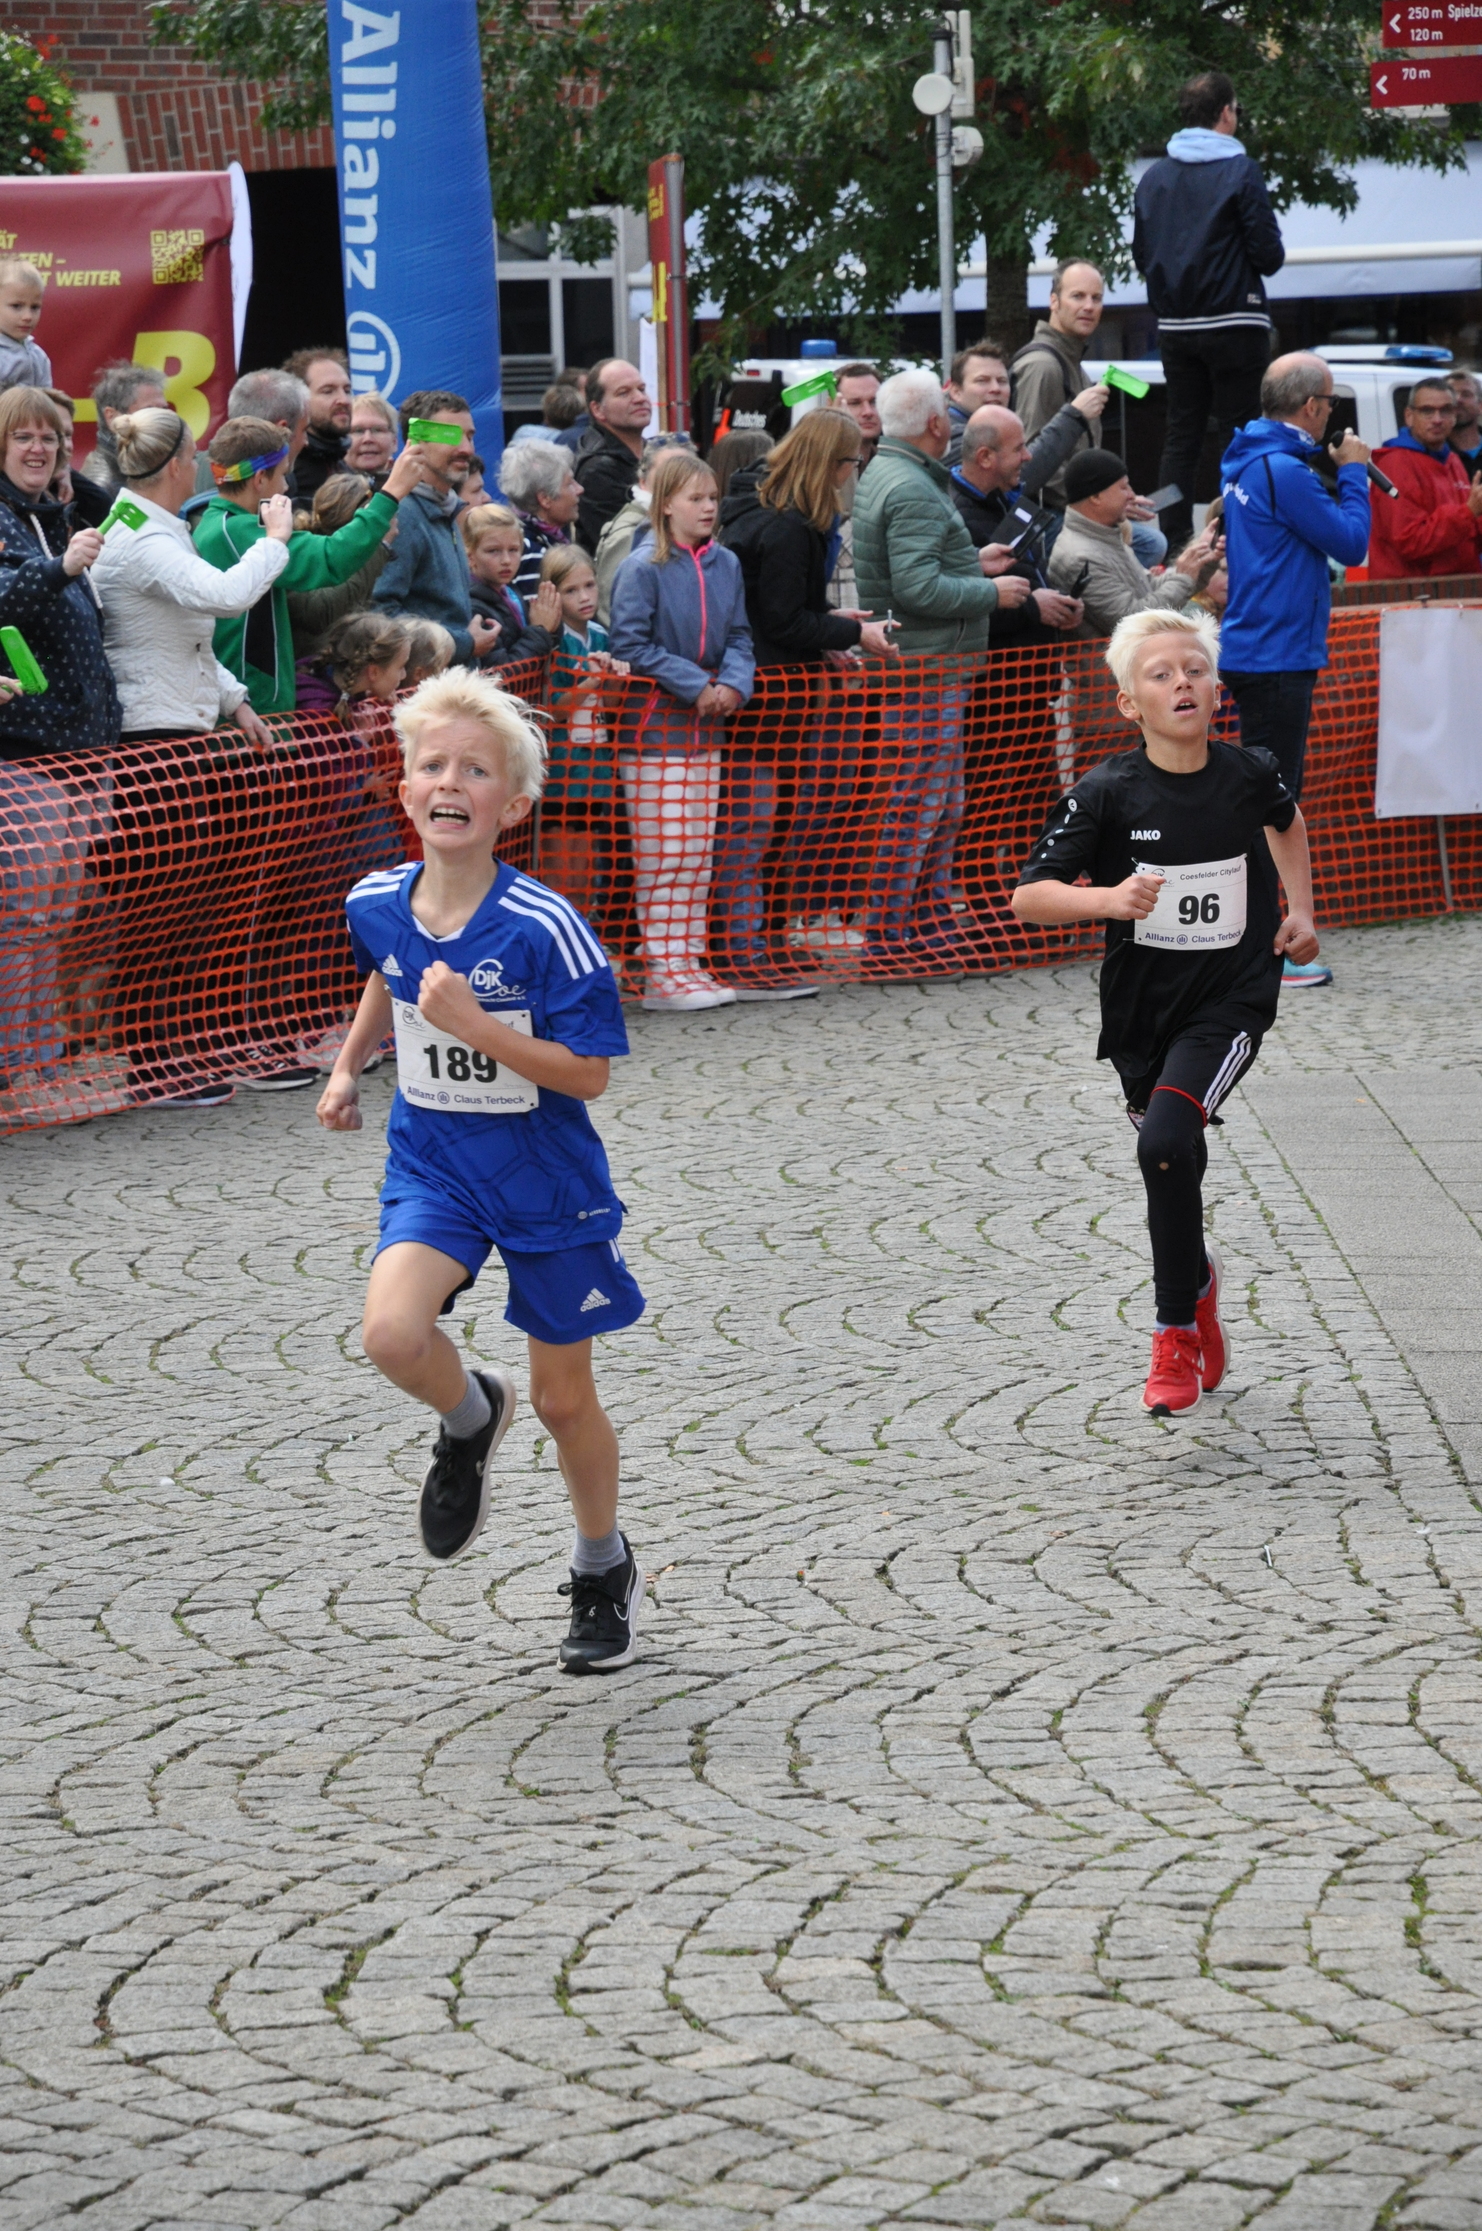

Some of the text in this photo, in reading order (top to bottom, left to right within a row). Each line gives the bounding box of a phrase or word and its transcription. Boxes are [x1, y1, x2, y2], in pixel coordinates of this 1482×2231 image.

[1408, 7, 1429, 20] 250
[1431, 9, 1443, 19] m
[1410, 28, 1443, 42] 120 m
[1402, 67, 1431, 81] 70 m
[341, 0, 400, 290] Allianz
[55, 270, 121, 287] WEITER
[1130, 829, 1161, 841] JAKO
[1179, 871, 1218, 881] Coesfelder
[1219, 864, 1242, 878] Citylauf
[1178, 893, 1220, 925] 96
[1144, 932, 1175, 943] Allianz
[1217, 929, 1242, 941] Terbeck
[423, 1044, 498, 1083] 189
[407, 1086, 526, 1105] Allianz Claus Terbeck
